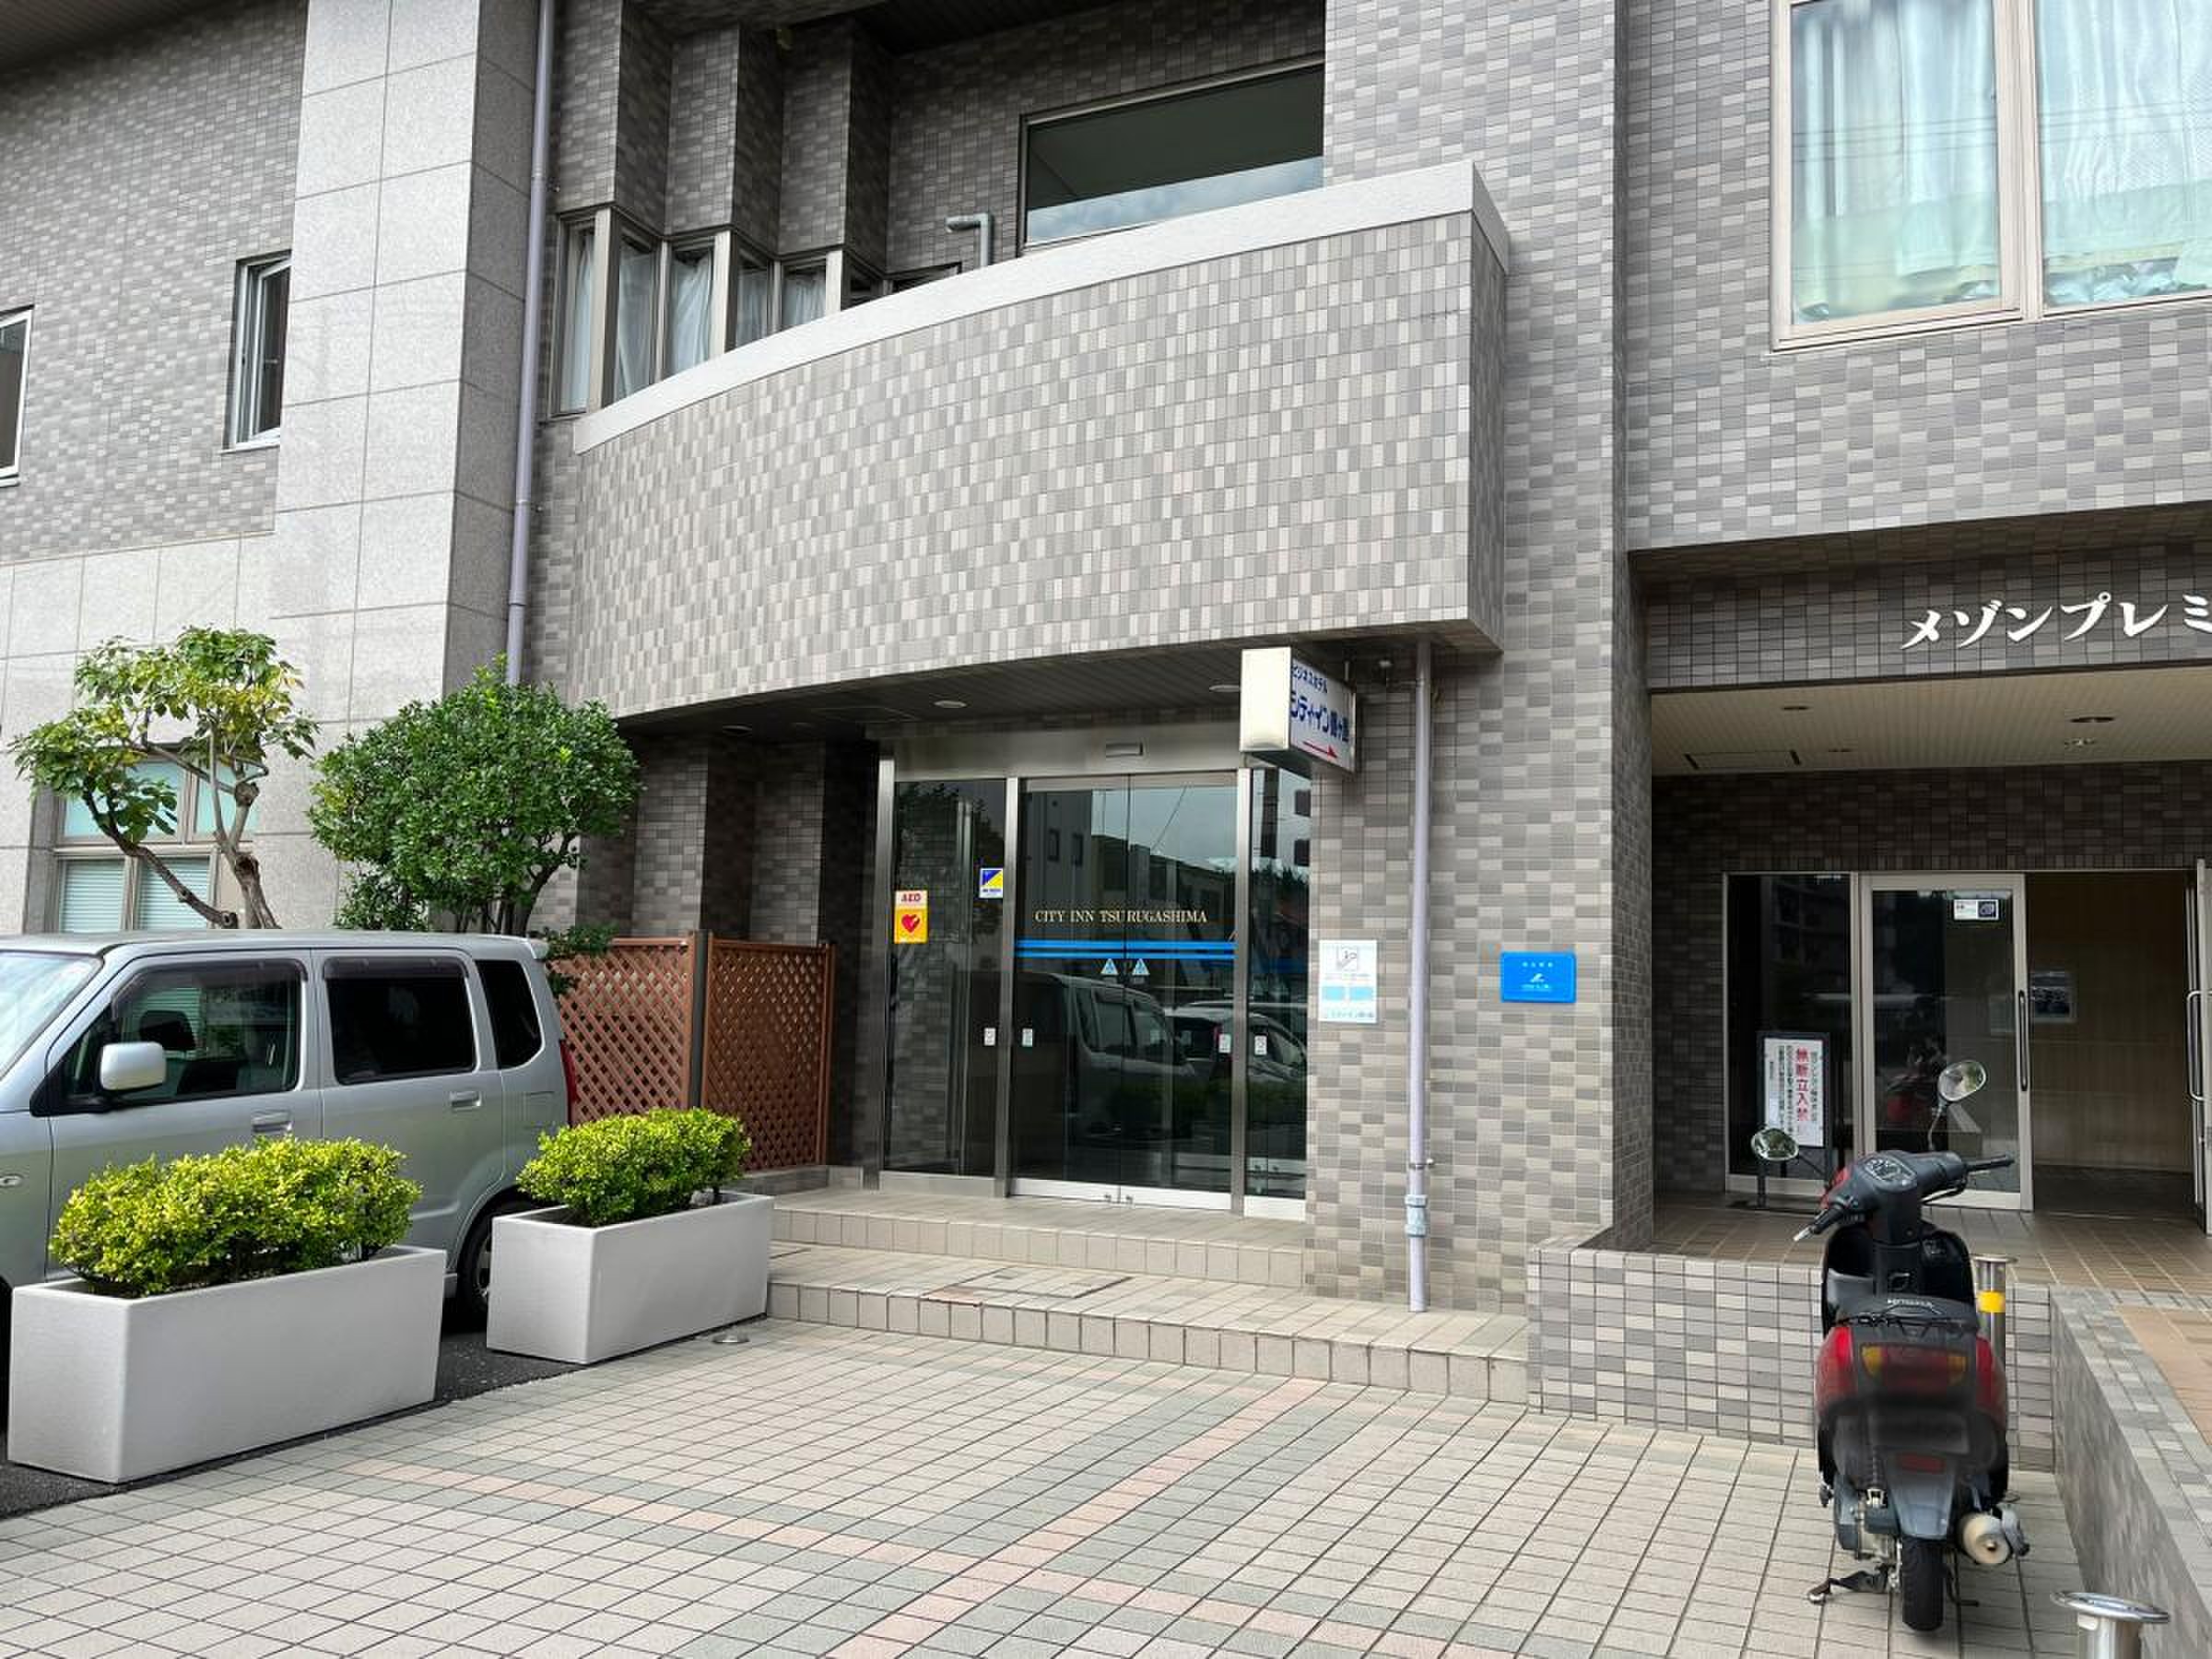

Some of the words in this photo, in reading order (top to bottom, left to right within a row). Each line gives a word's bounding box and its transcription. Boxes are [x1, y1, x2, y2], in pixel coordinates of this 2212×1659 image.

[1900, 591, 2212, 650] メゾンプレミ
[900, 892, 922, 902] AED
[1034, 909, 1065, 923] CITY
[1070, 909, 1094, 923] INN
